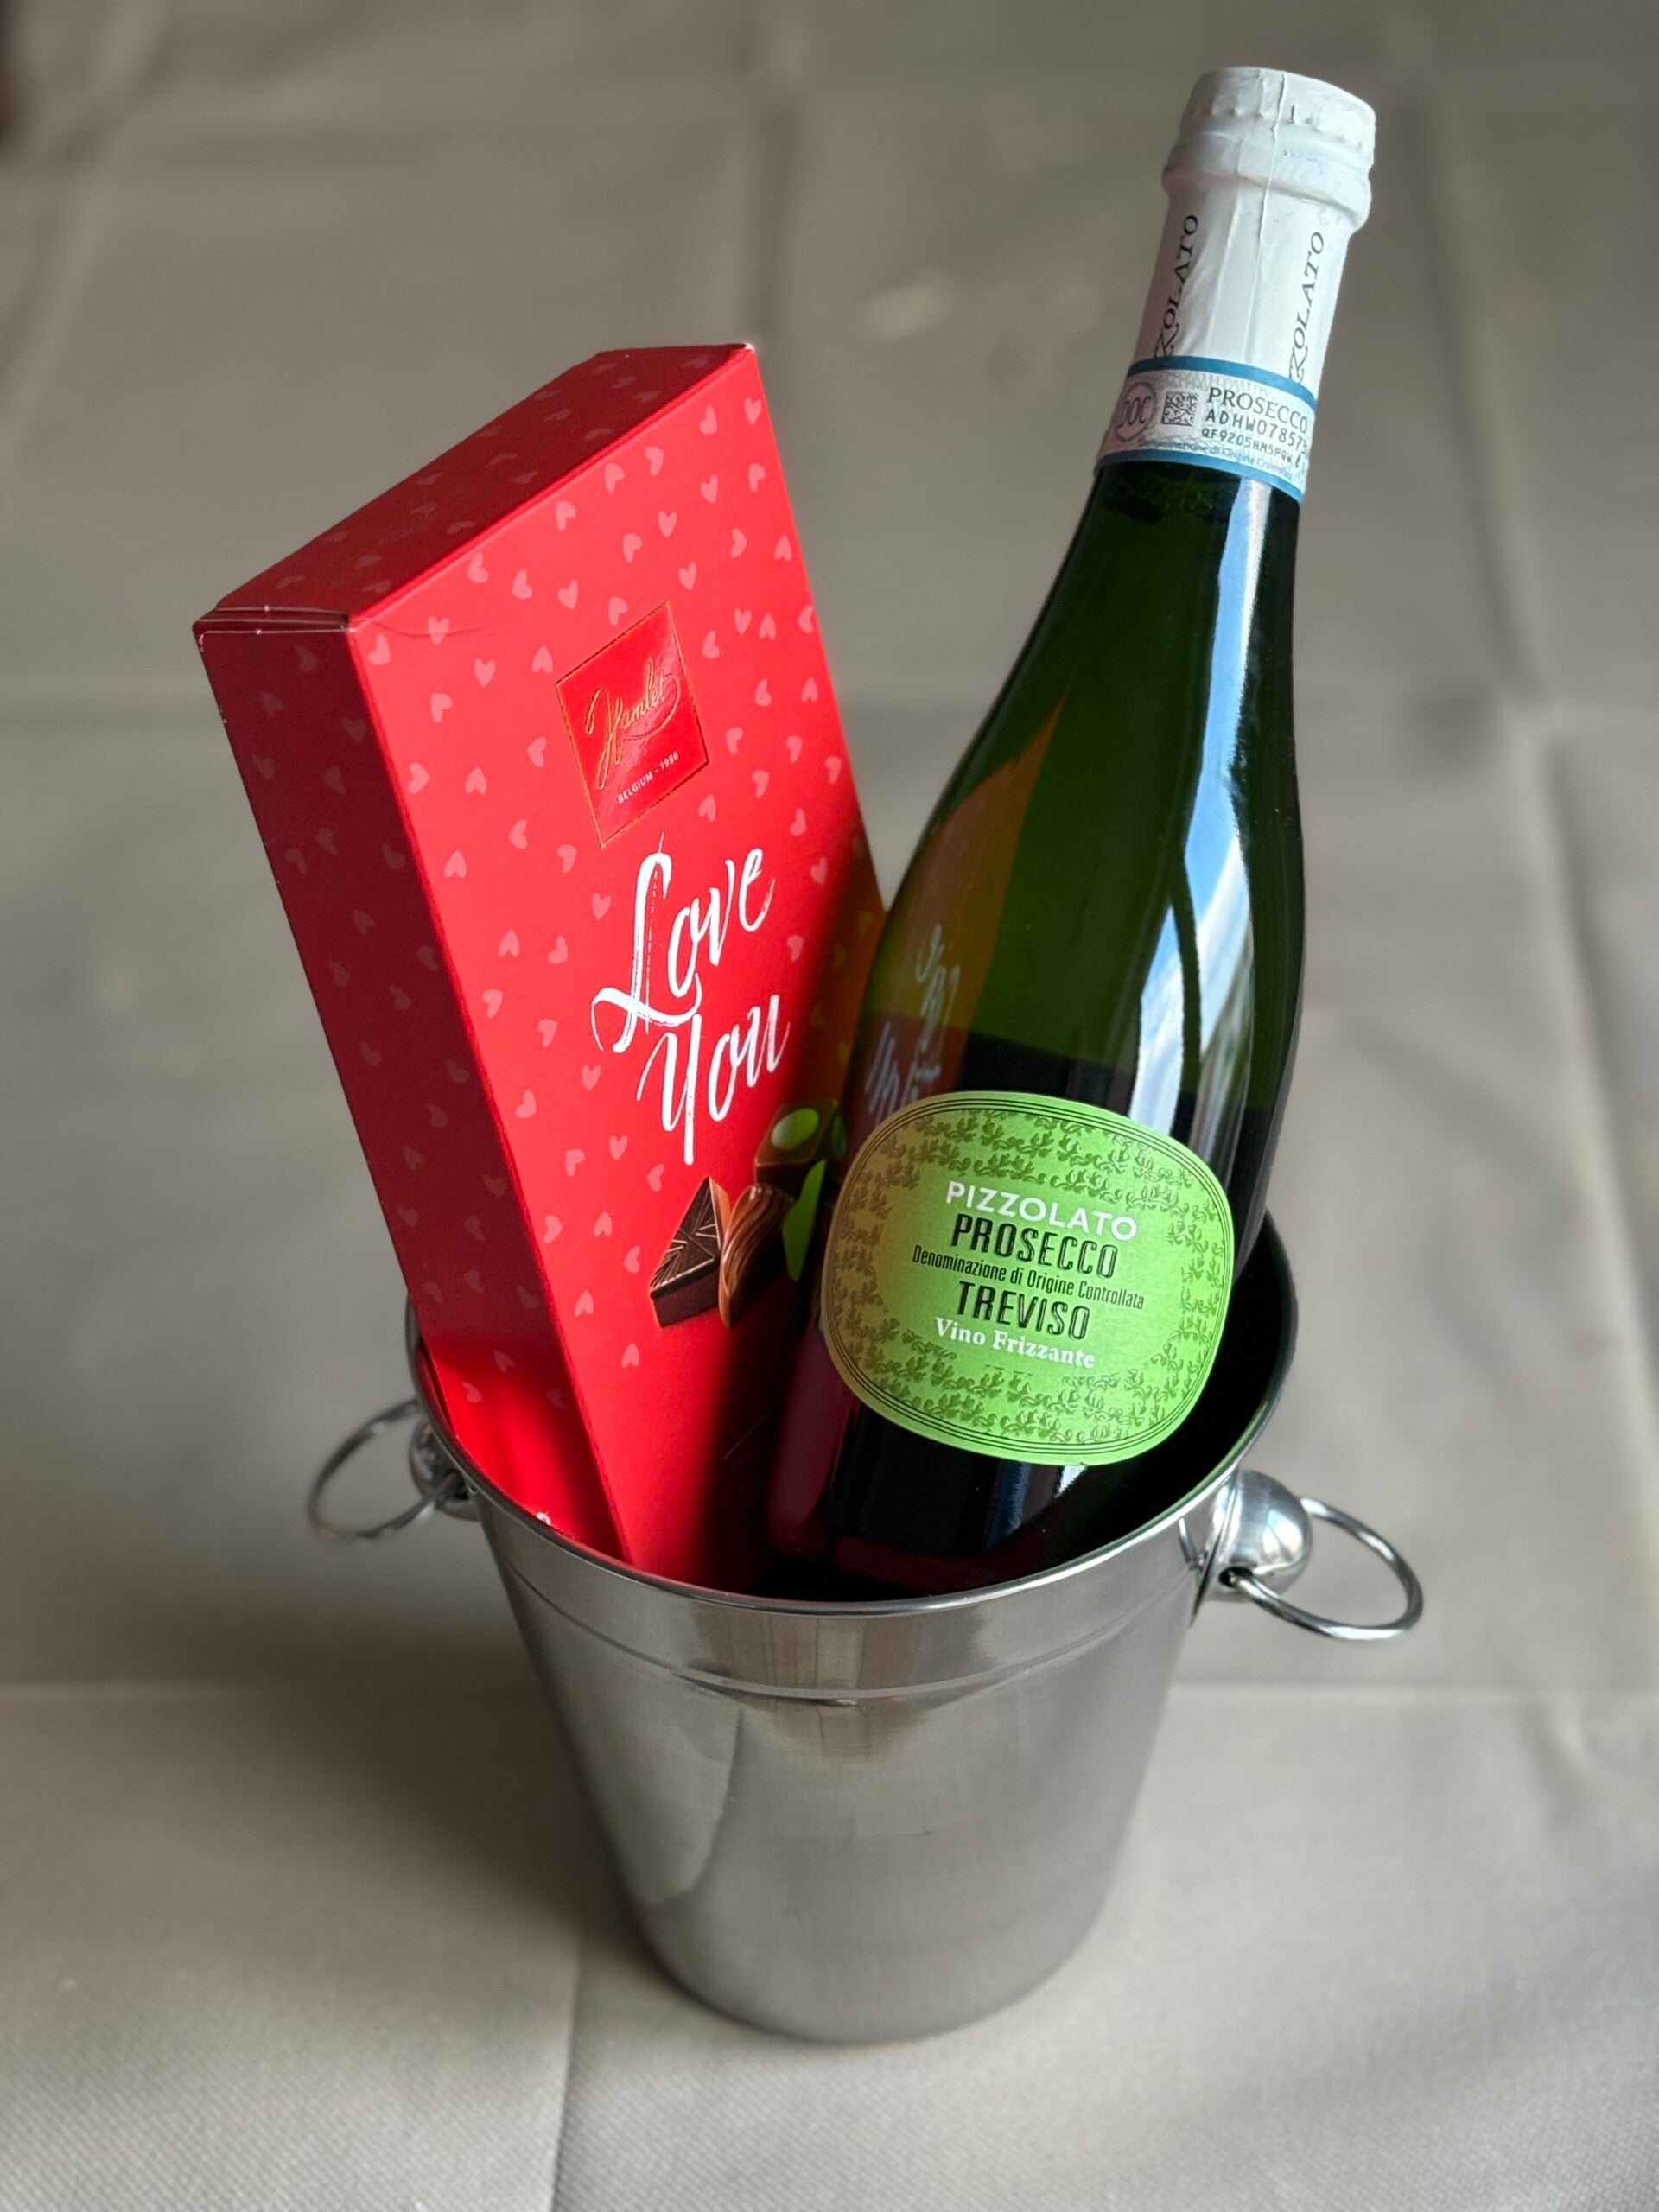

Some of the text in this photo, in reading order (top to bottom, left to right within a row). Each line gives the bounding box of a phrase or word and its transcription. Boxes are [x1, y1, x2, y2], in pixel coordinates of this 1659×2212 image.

[1154, 215, 1198, 358] ZOLATO
[1289, 232, 1324, 383] ZOLATO
[1207, 386, 1308, 434] PROSECCO
[586, 657, 681, 791] Hamlet
[617, 770, 654, 804] BELGIUM
[591, 832, 776, 1053] Love
[636, 995, 791, 1166] You
[945, 1180, 1138, 1242] PIZZOLATO
[912, 1244, 1145, 1310] Denominazione di Origine Controllata
[950, 1212, 1119, 1280] PROSECCO
[935, 1316, 1096, 1369] Vino Frizzante
[957, 1280, 1090, 1340] TREVISO
